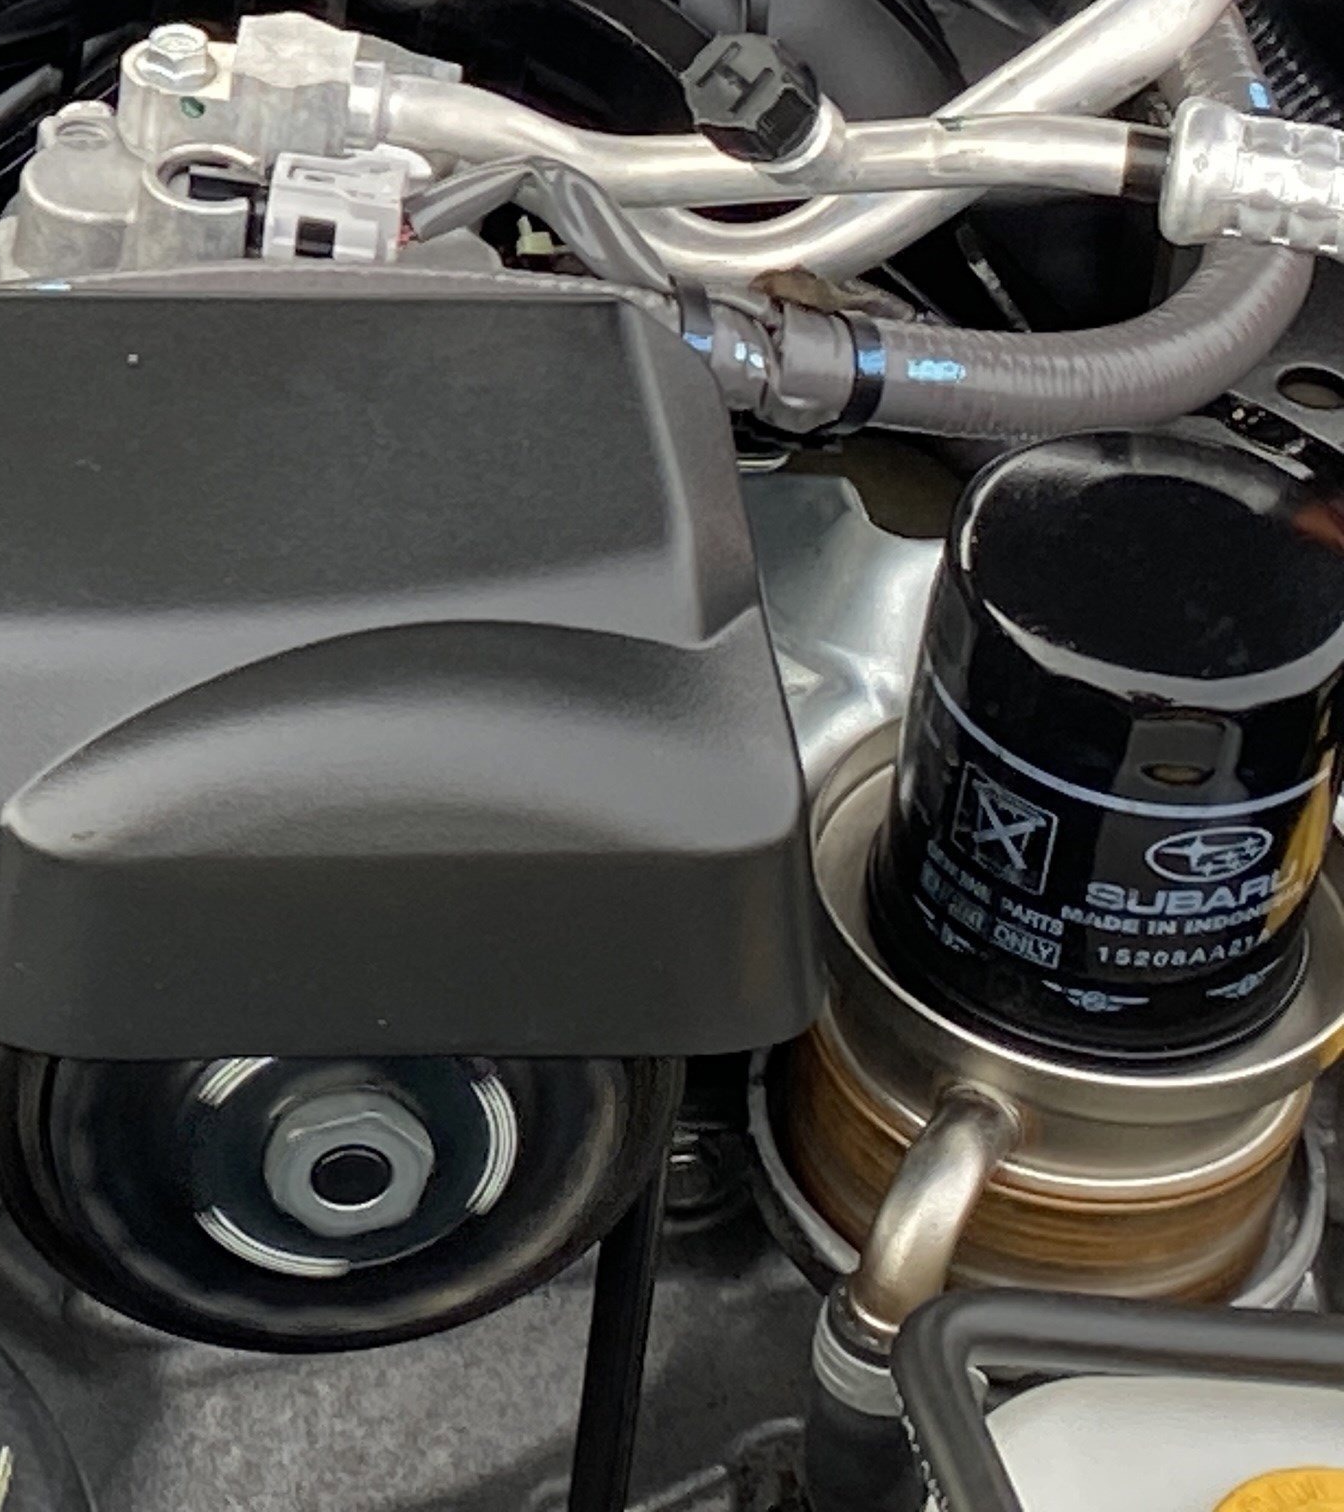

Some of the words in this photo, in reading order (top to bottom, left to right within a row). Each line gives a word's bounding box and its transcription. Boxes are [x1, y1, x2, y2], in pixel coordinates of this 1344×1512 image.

[696, 41, 775, 113] H
[1001, 896, 1063, 936] PARTS
[1061, 904, 1140, 934] MADE
[1146, 919, 1177, 936] IN
[993, 923, 1056, 962] ONLY
